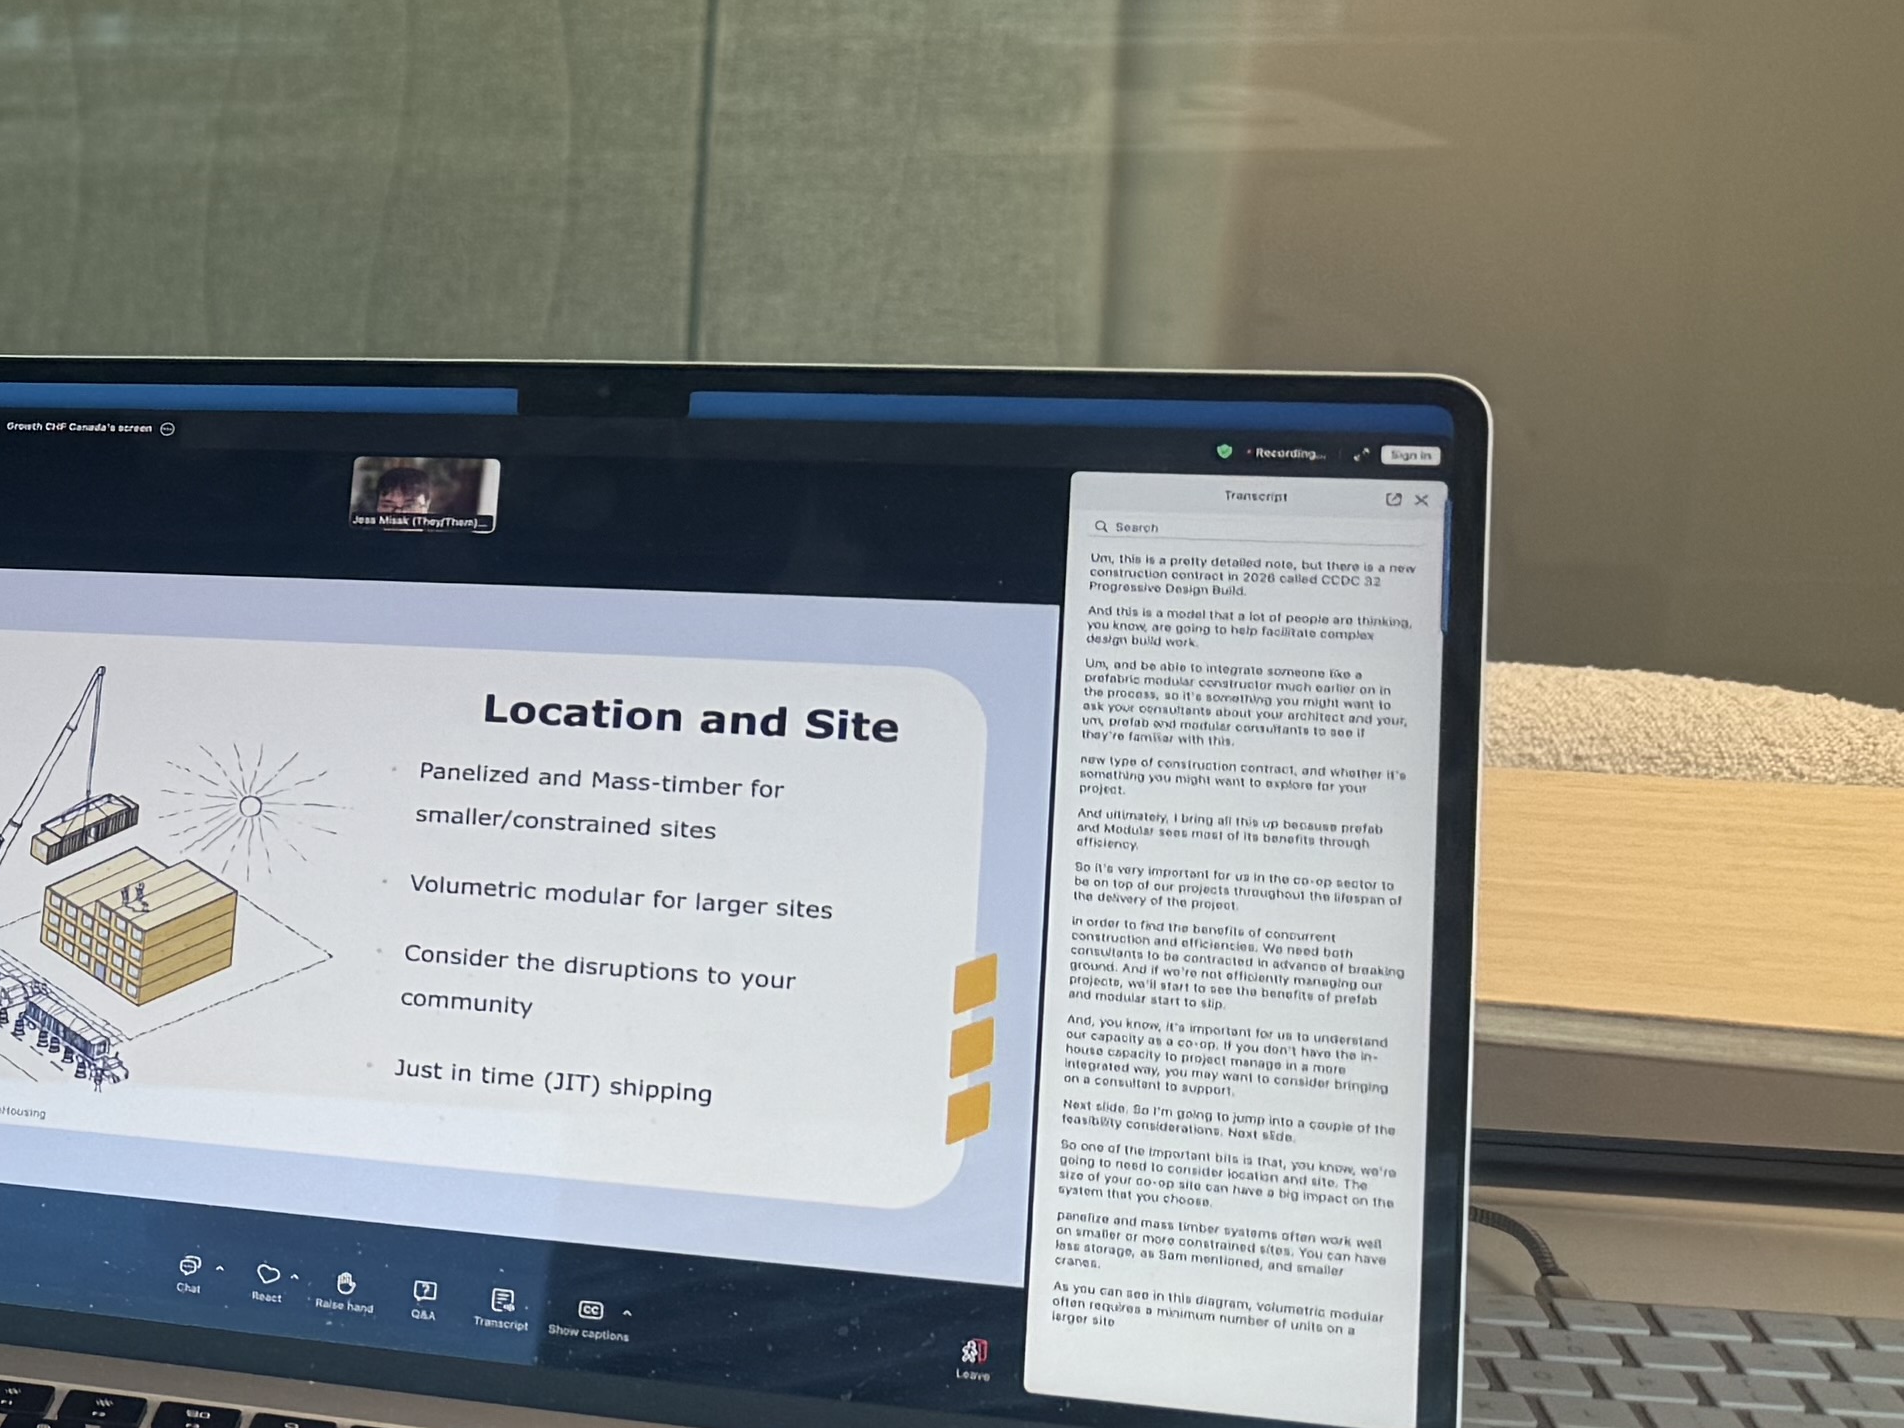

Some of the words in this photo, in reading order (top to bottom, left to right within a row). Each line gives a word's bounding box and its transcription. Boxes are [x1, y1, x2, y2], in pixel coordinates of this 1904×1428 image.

[1225, 489, 1288, 503] Transcript
[1115, 522, 1159, 534] Search
[484, 693, 682, 732] Location
[700, 706, 787, 737] and
[805, 708, 899, 743] Site
[420, 761, 529, 784] Panelized
[538, 769, 582, 788] and
[592, 771, 743, 797] Mass-timber
[751, 778, 785, 799] for
[415, 807, 651, 836] smaller/constrained
[660, 820, 716, 840] sites
[410, 874, 537, 900] Volumetric
[545, 885, 646, 907] modular
[653, 889, 688, 910] for
[695, 892, 769, 918] larger
[776, 899, 833, 920] sites
[404, 944, 509, 968] Consider
[517, 952, 555, 972] the
[564, 956, 698, 983] disruptions
[708, 966, 731, 985] to
[741, 972, 797, 991] your
[400, 992, 533, 1020] community
[394, 1058, 443, 1080] Just
[451, 1063, 471, 1083] in
[481, 1066, 534, 1088] time
[544, 1071, 600, 1098] (JIT)
[610, 1077, 712, 1108] shipping
[176, 1282, 201, 1294] Chat
[251, 1290, 282, 1303] React
[315, 1297, 345, 1310] Raise
[346, 1300, 374, 1314] hand
[410, 1308, 436, 1321] Q&A
[474, 1315, 529, 1332] Transcript
[548, 1323, 580, 1337] Show
[581, 1329, 630, 1343] captions
[956, 1368, 991, 1382] Leave
